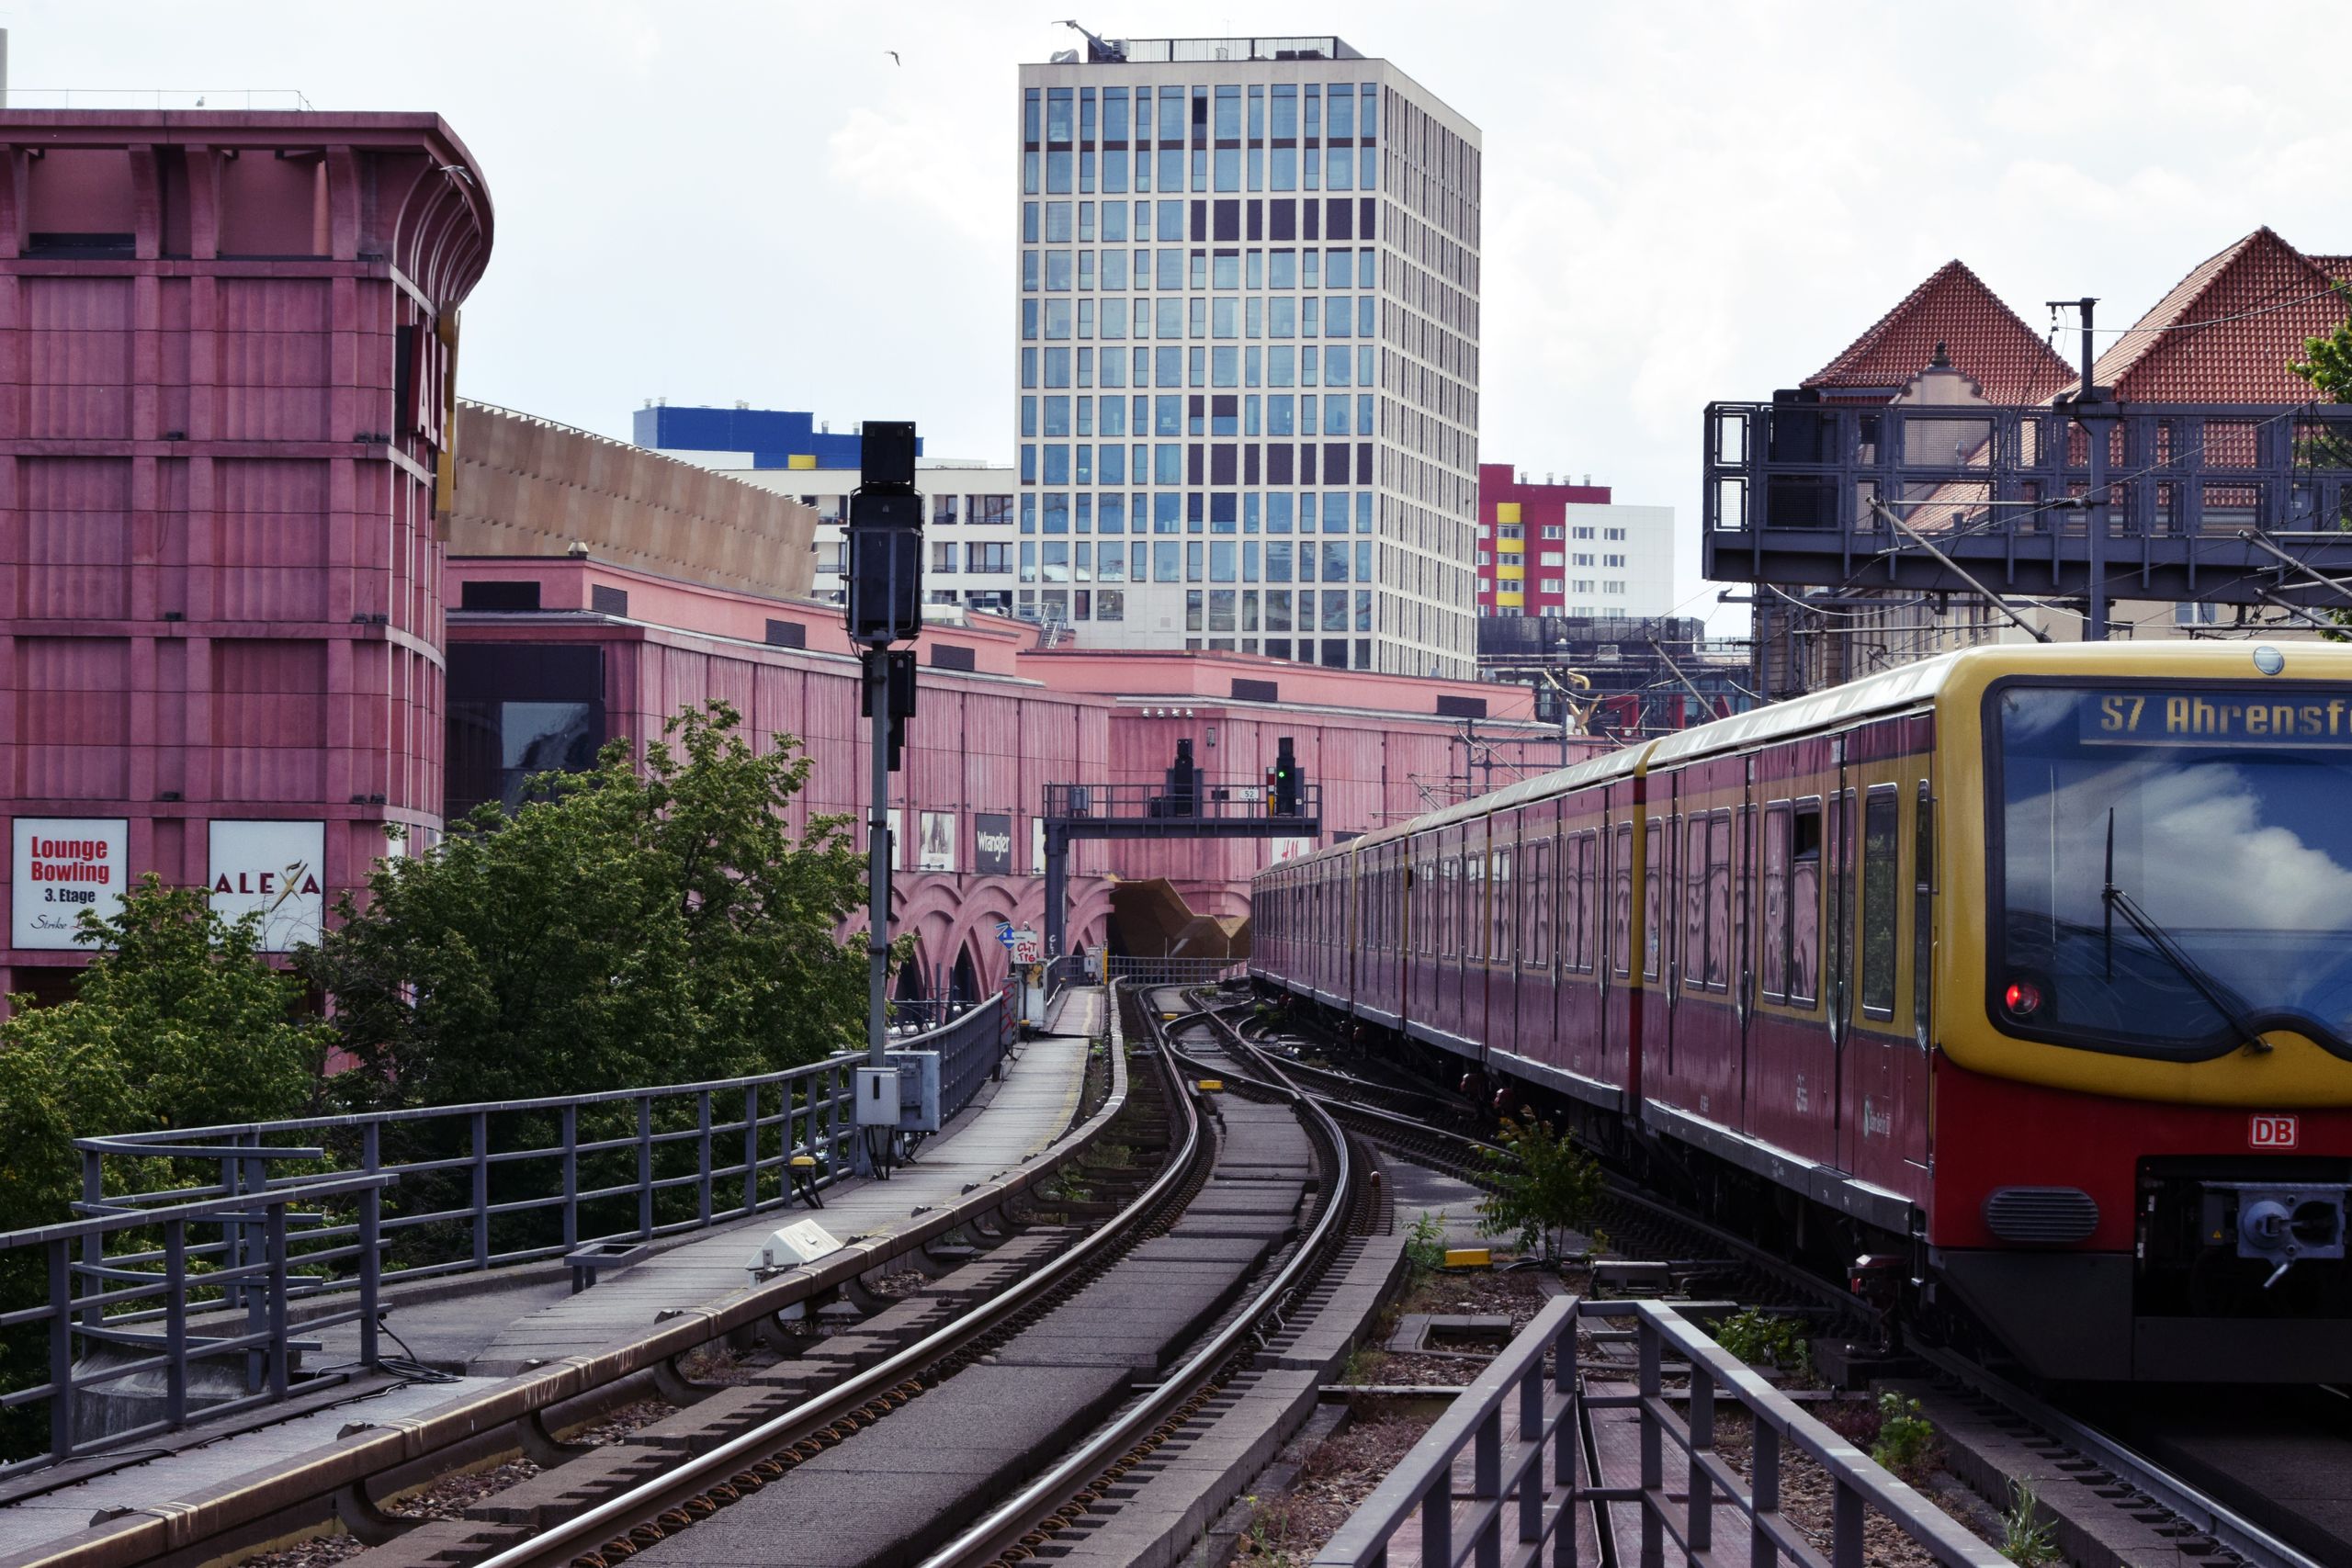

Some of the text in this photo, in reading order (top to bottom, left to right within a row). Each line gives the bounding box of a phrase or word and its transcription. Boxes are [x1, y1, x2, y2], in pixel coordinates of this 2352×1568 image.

[2101, 696, 2352, 736] S7 Ahrensf
[31, 836, 107, 862] Lounge
[978, 830, 1010, 863] Wrangler
[31, 861, 109, 885] Bowling
[44, 887, 96, 904] 3. Etage
[215, 863, 321, 912] ALEXA
[2256, 1119, 2292, 1143] DB
